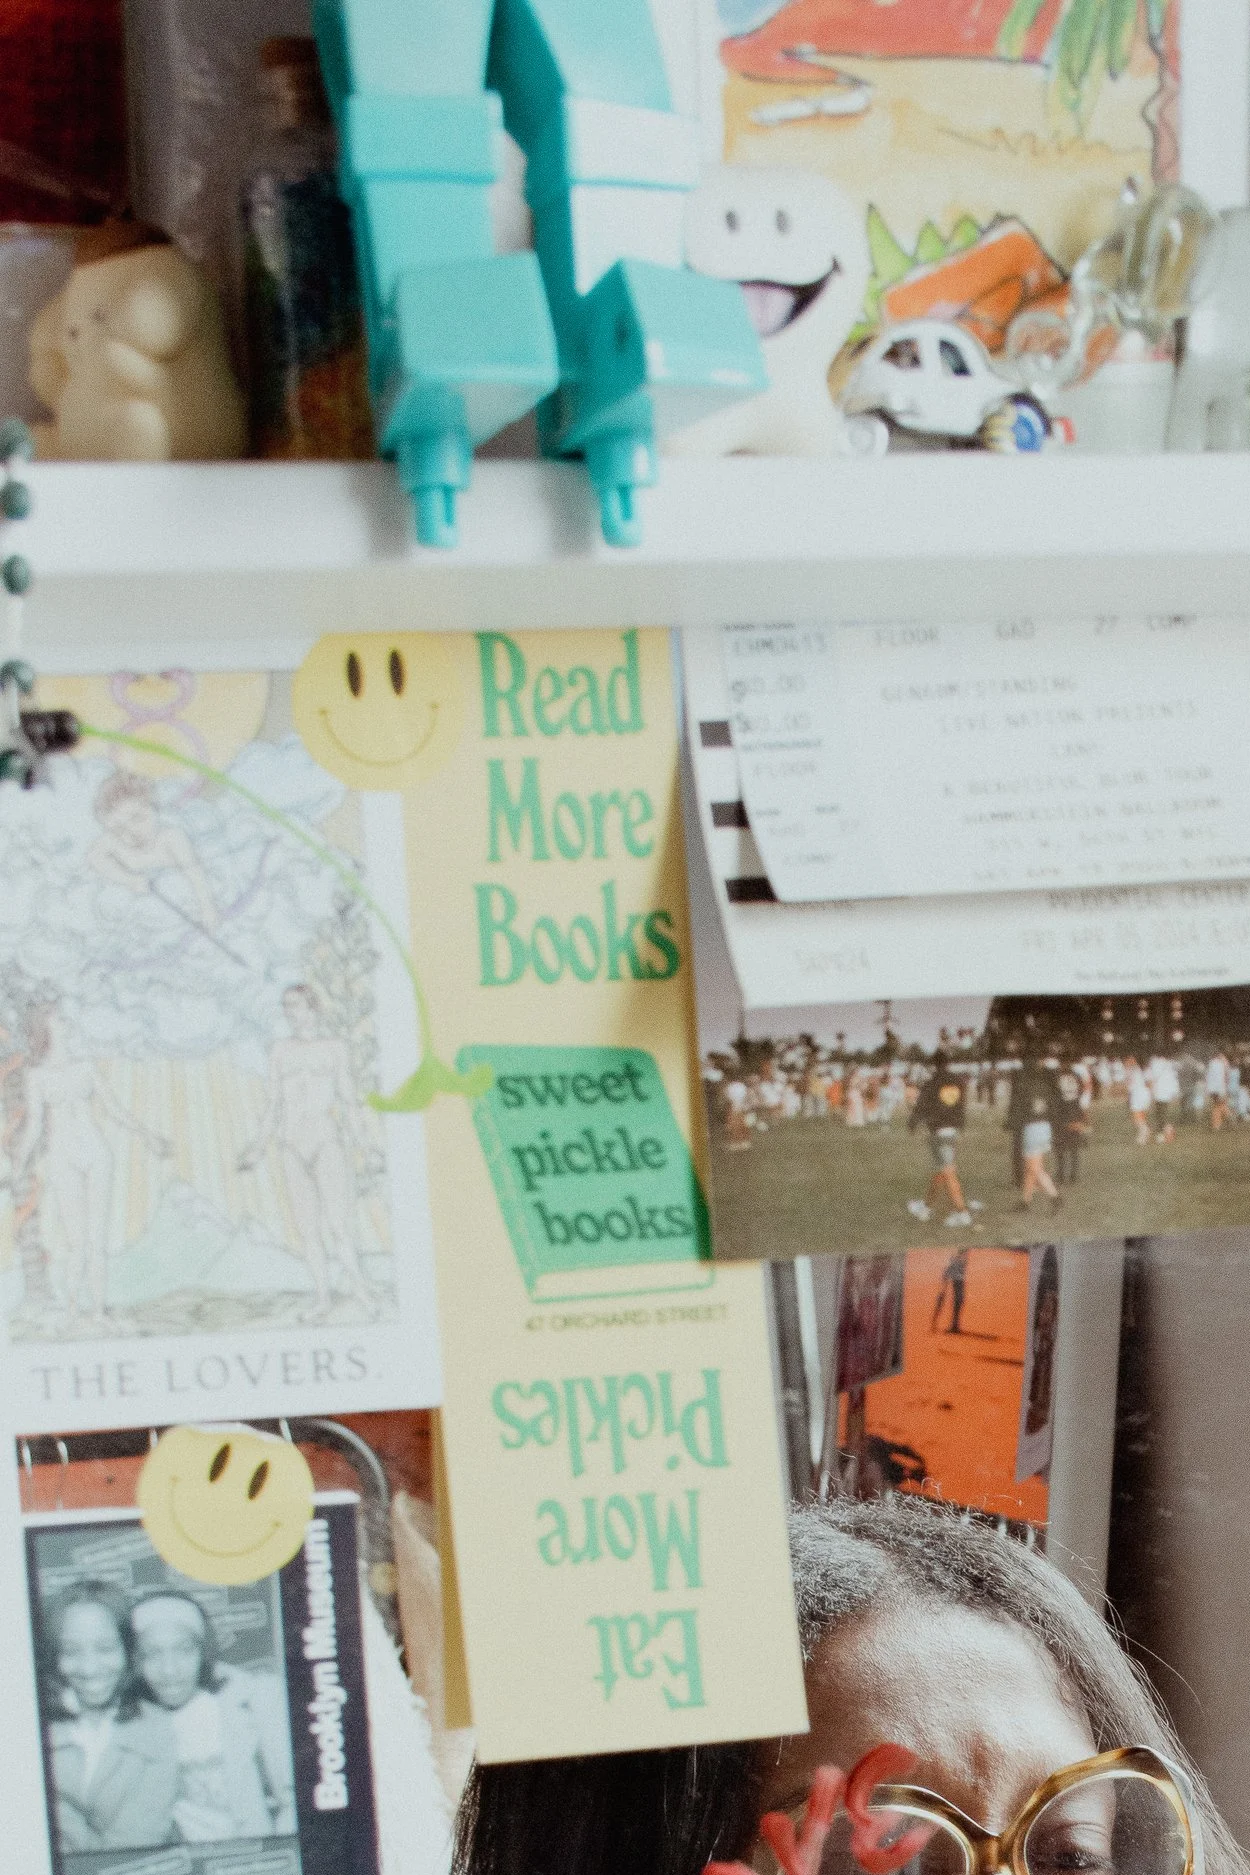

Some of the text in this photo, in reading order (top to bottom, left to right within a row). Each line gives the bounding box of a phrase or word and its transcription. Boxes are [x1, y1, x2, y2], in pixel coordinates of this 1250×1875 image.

[474, 630, 645, 739] Read
[487, 759, 656, 863] More
[473, 880, 681, 987] Books
[496, 1063, 651, 1110] sweet
[511, 1125, 668, 1191] pickle
[536, 1184, 693, 1248] books
[549, 1309, 650, 1332] ORCHARD
[654, 1303, 729, 1325] STREET
[30, 1358, 142, 1402] THE
[491, 1367, 730, 1711] Eat More Pickles
[302, 1518, 350, 1812] Brooklyn Museum
